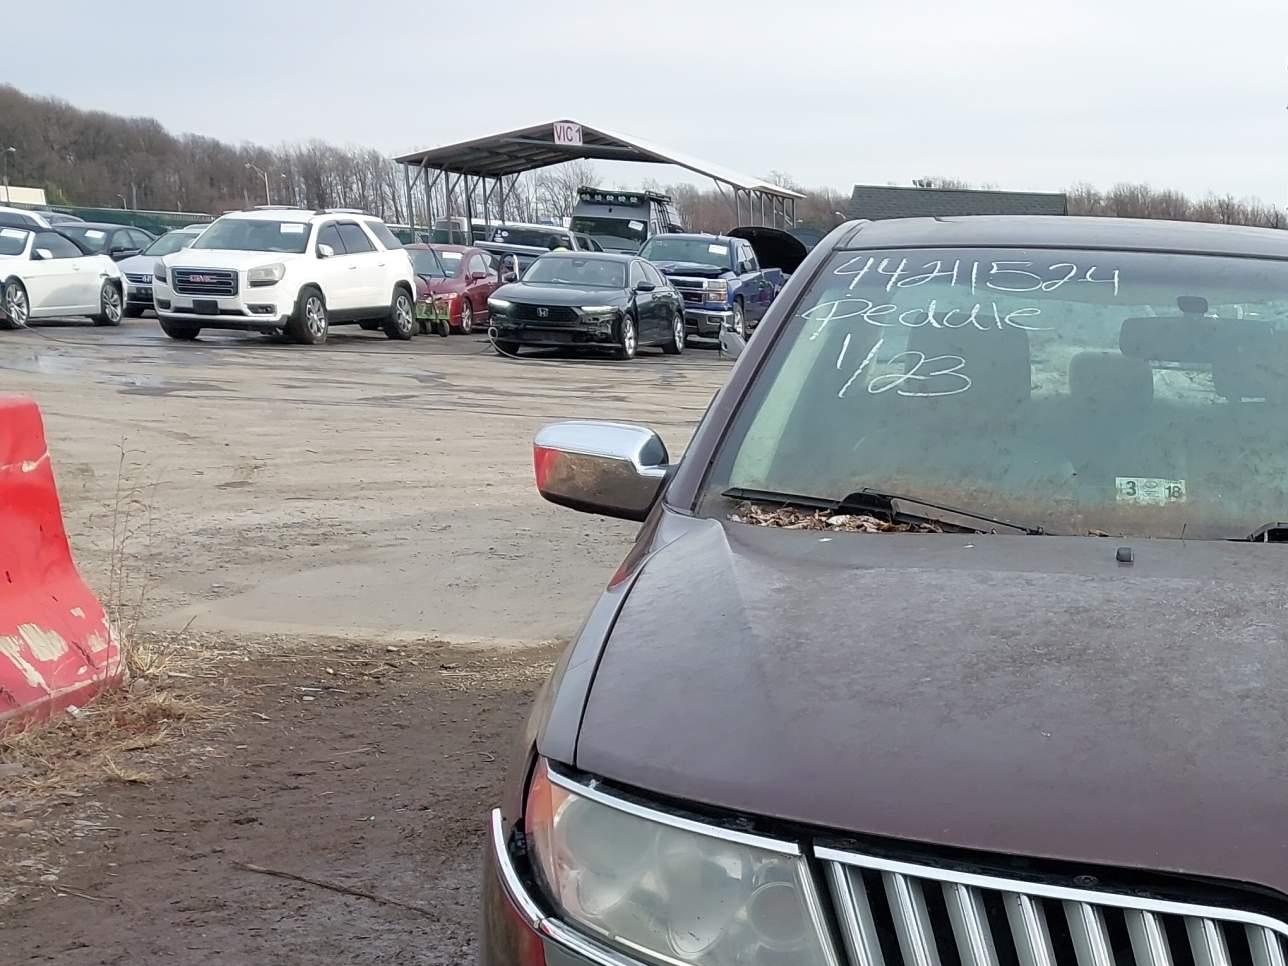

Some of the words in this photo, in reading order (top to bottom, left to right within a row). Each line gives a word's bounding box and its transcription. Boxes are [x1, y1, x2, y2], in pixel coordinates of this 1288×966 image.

[554, 125, 574, 142] VIC
[576, 126, 582, 143] 1
[836, 333, 972, 398] 1/23
[1126, 481, 1137, 496] 3
